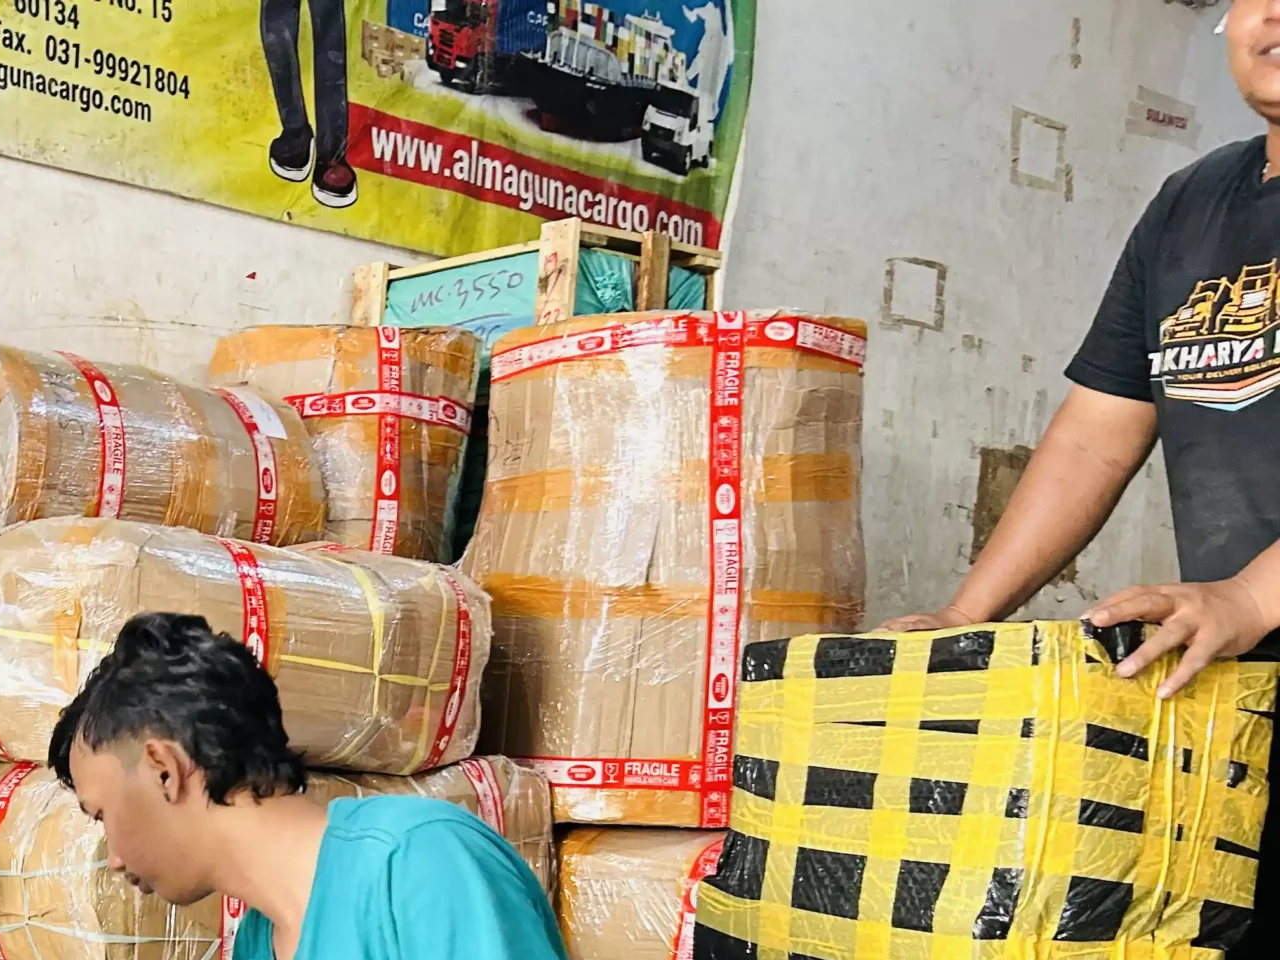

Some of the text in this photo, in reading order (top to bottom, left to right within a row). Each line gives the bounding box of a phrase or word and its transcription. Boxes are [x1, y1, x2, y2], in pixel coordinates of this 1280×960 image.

[45, 35, 190, 100] 031-99921804
[370, 125, 705, 248] www.almagunacargo.com
[723, 351, 741, 406] FRAGILE
[111, 426, 123, 476] FRAGILE
[381, 519, 395, 555] FRAGI
[724, 541, 738, 595] FRAGILE
[624, 762, 680, 778] FRAGILE
[624, 776, 680, 787] HANDLE WITH CARE
[715, 729, 729, 782] FRAGILE
